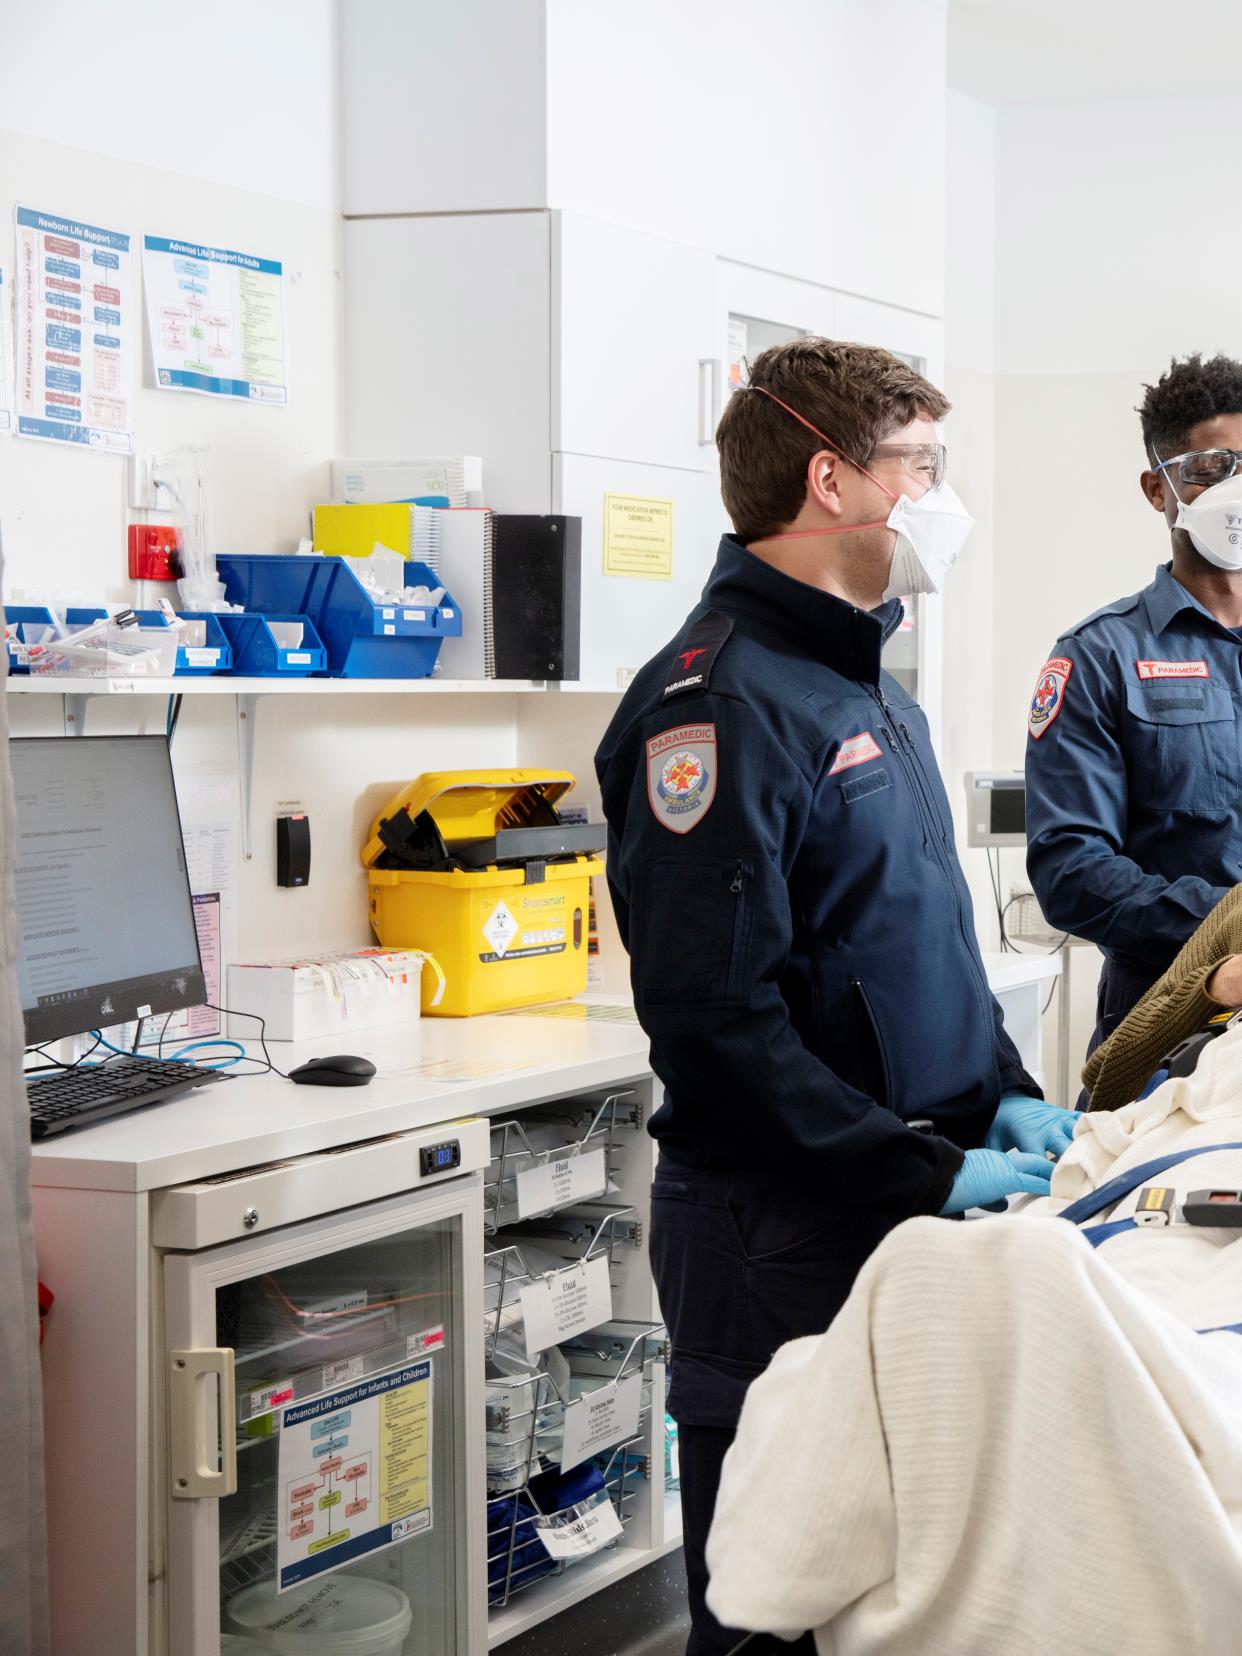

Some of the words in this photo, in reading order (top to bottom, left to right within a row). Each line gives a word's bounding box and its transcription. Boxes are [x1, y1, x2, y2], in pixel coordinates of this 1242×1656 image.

[38, 217, 69, 233] Newborn
[70, 225, 82, 236] Life
[84, 228, 110, 244] Support
[169, 242, 197, 256] Advanced
[210, 251, 237, 263] Support
[664, 675, 703, 695] PARAMEDIC
[651, 729, 712, 752] PARAMEDIC
[286, 1405, 319, 1422] Advanced
[321, 1399, 333, 1410] Life
[333, 1390, 358, 1406] Support
[358, 1386, 367, 1397] for
[368, 1379, 389, 1392] Infants
[390, 1376, 402, 1386] and
[402, 1367, 428, 1381] Children
